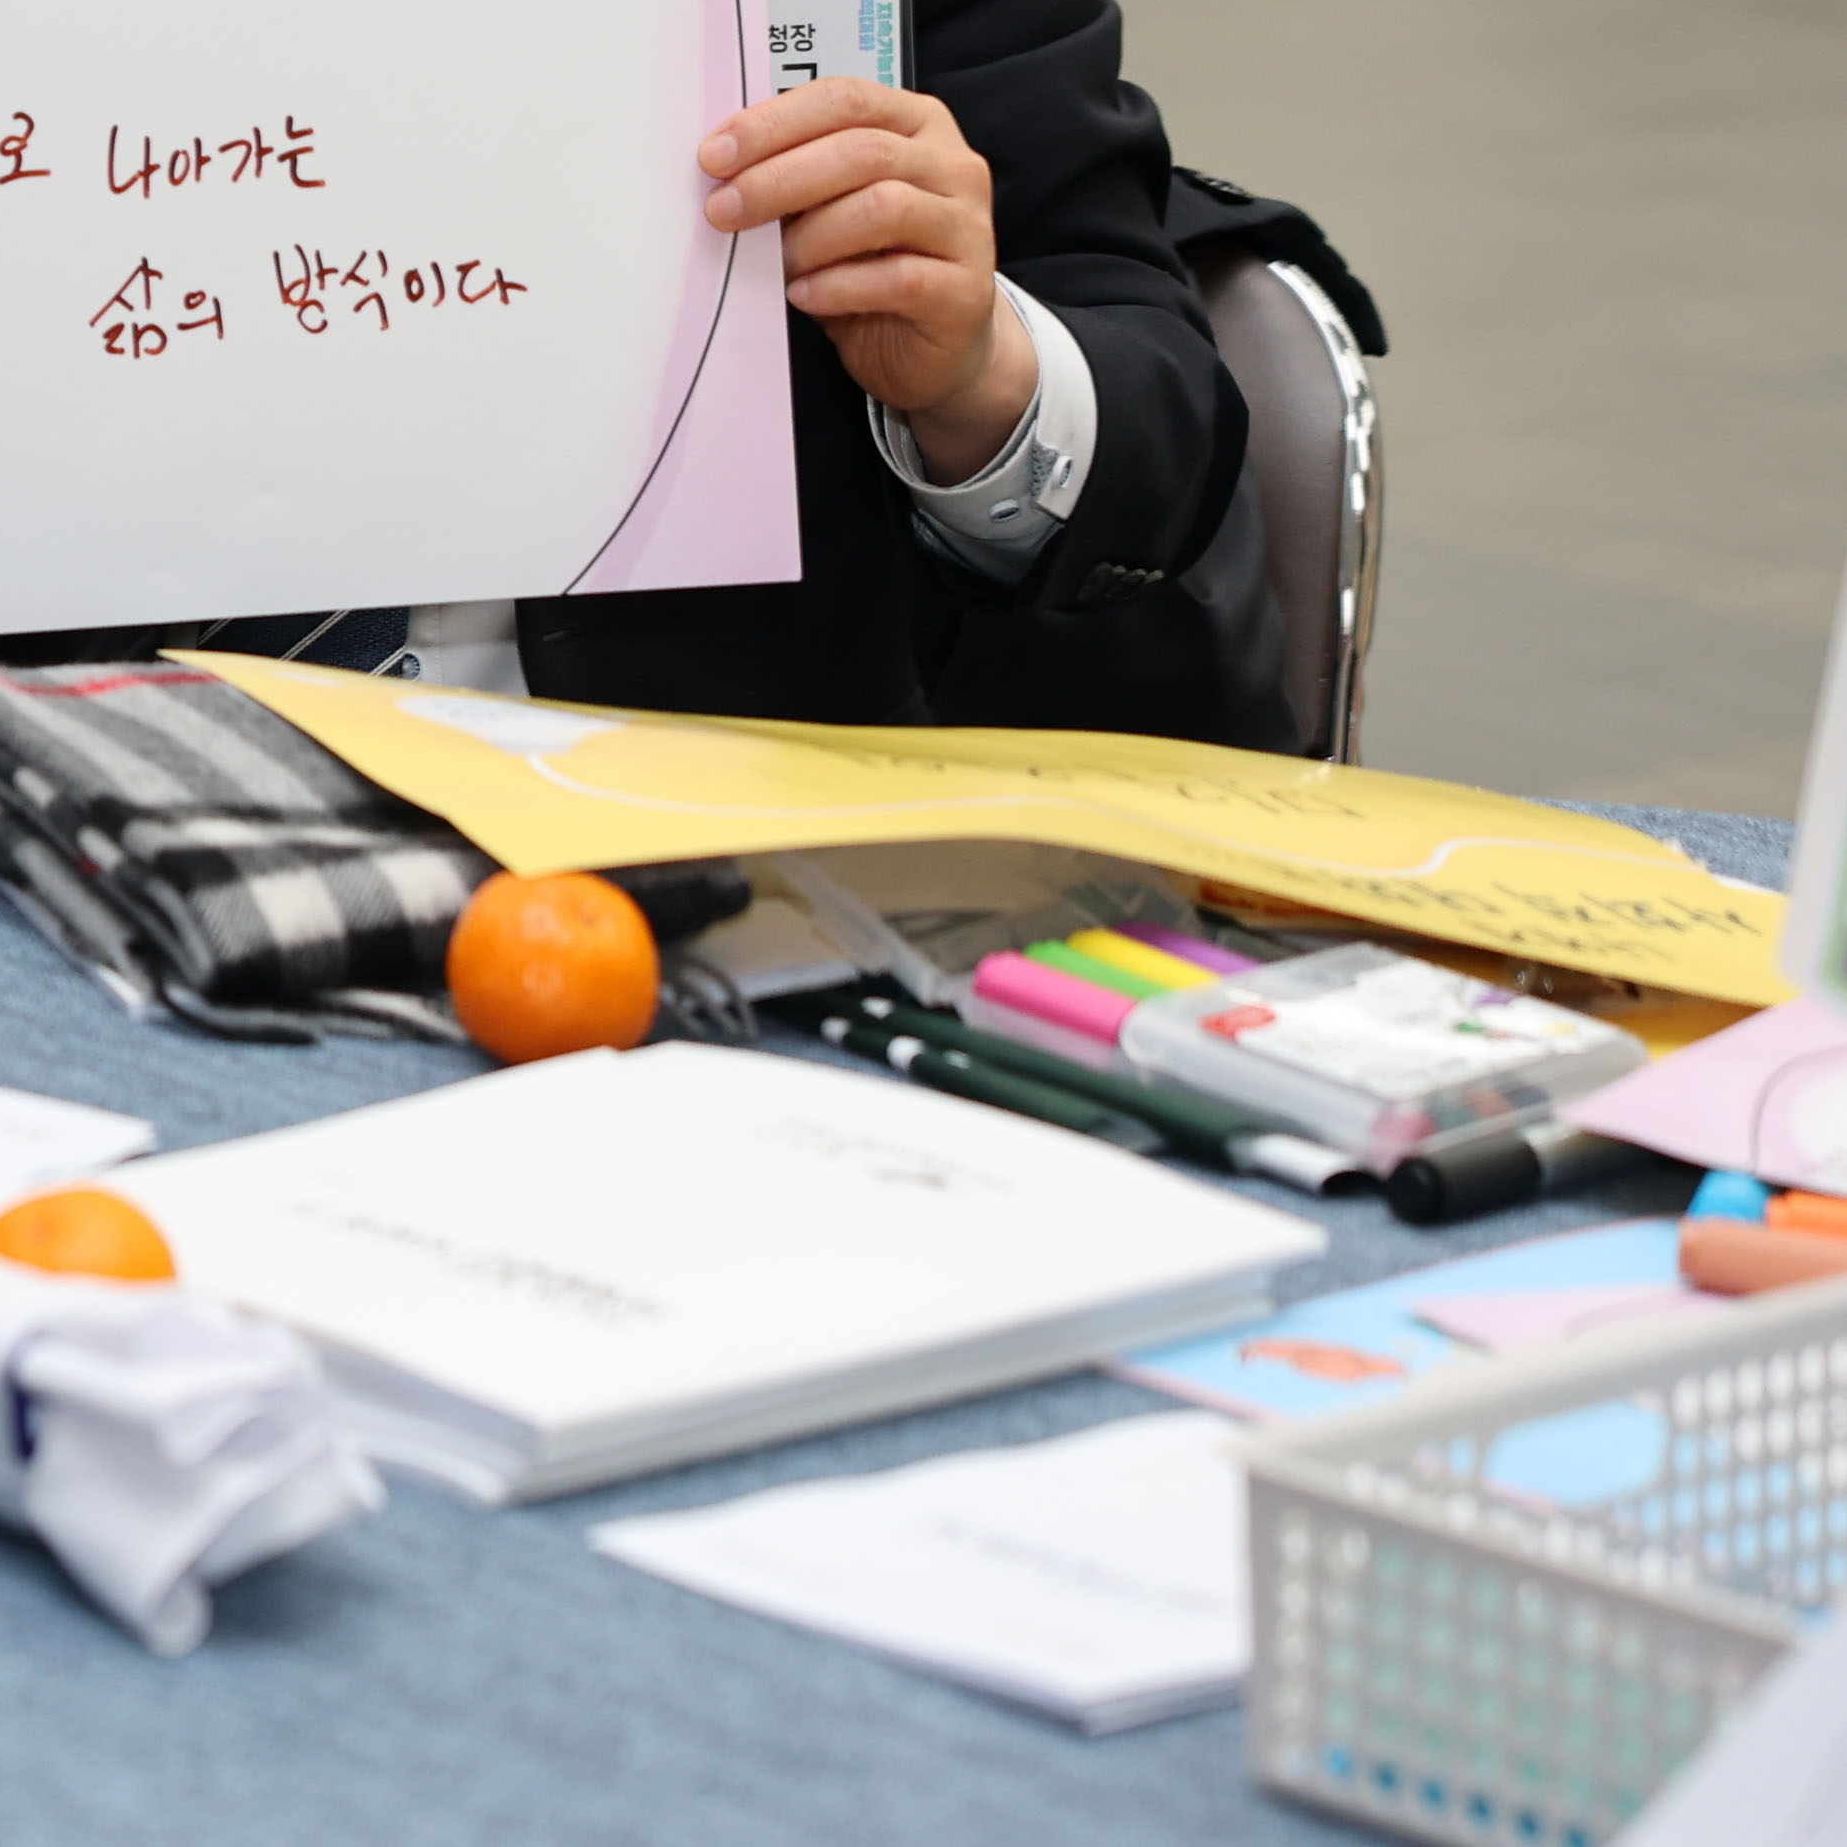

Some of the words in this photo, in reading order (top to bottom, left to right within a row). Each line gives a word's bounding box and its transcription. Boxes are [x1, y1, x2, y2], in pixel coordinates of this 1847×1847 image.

[107, 115, 326, 200] 나아가는
[88, 256, 224, 360] 삶의
[272, 243, 528, 335] 방식이다
